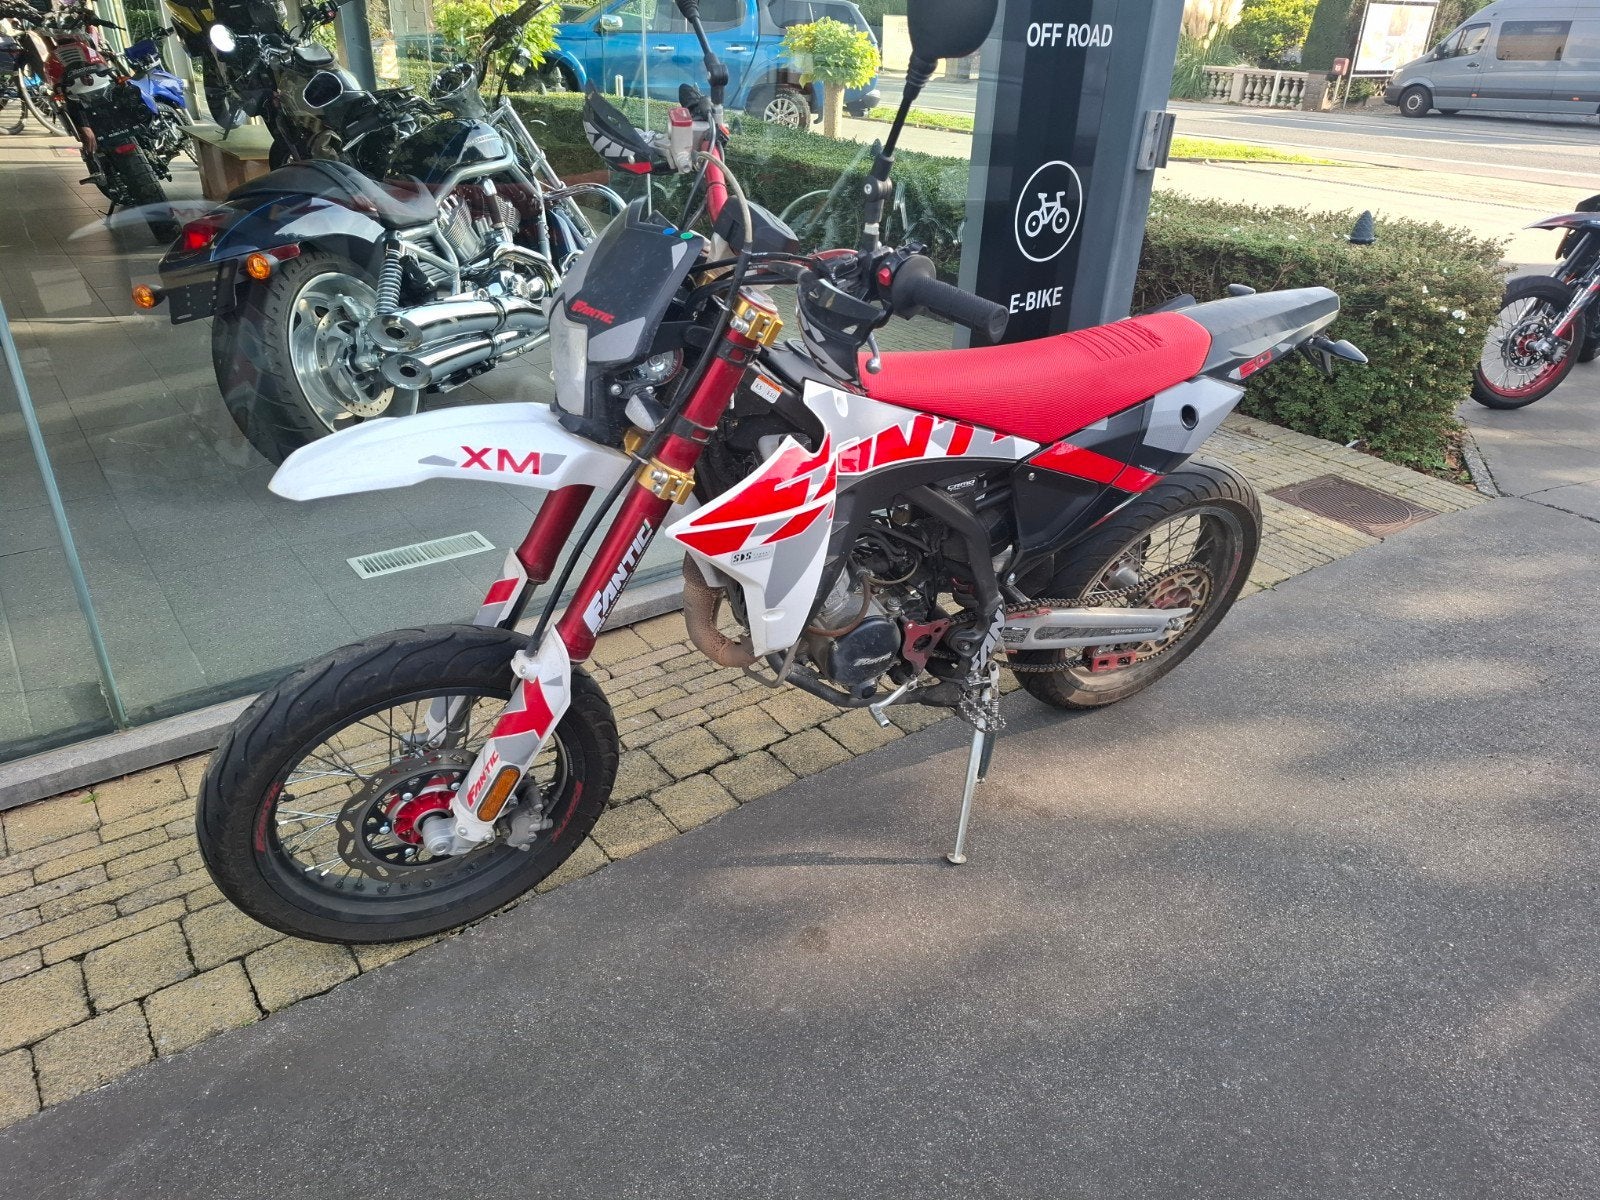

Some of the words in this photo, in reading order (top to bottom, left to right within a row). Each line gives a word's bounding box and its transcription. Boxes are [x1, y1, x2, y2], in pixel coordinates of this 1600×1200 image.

[1026, 22, 1063, 48] OFF
[1066, 23, 1113, 48] ROAD
[1009, 286, 1064, 315] E-BIKE
[460, 445, 541, 476] XM
[582, 518, 653, 635] FANTIC
[466, 750, 499, 808] FANTIC
